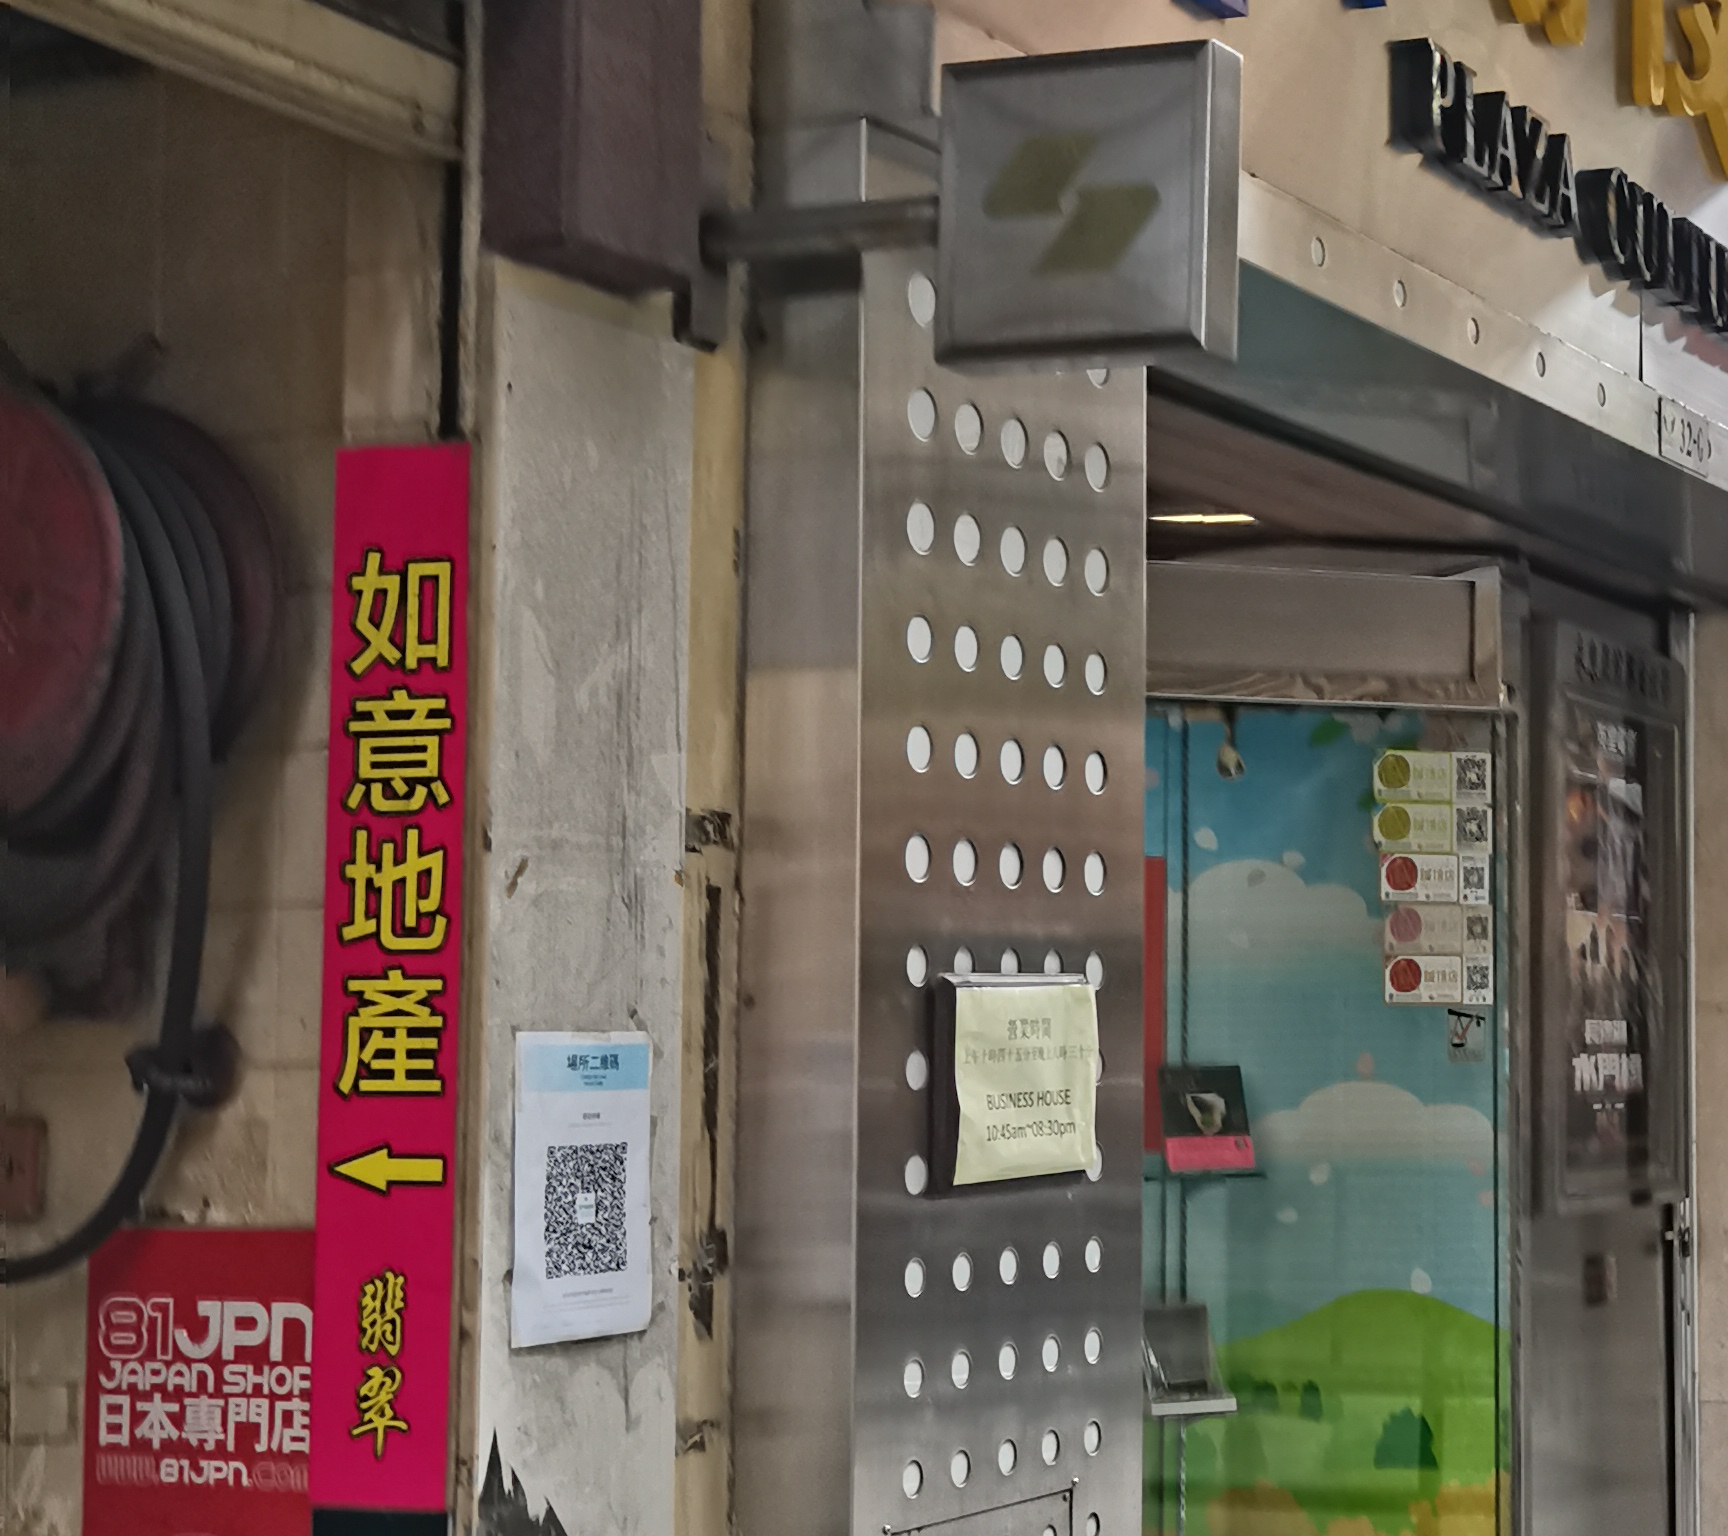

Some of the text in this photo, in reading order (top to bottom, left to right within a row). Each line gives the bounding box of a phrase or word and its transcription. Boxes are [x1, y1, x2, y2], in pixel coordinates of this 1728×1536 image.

[1386, 37, 1582, 236] PLAZA
[332, 547, 455, 1101] 如意地產
[986, 1088, 1072, 1110] BUSINESS HOUSE
[98, 1360, 215, 1393] JAPAN
[98, 1393, 311, 1454] 日本專門店
[351, 1270, 410, 1459] 翡翠
